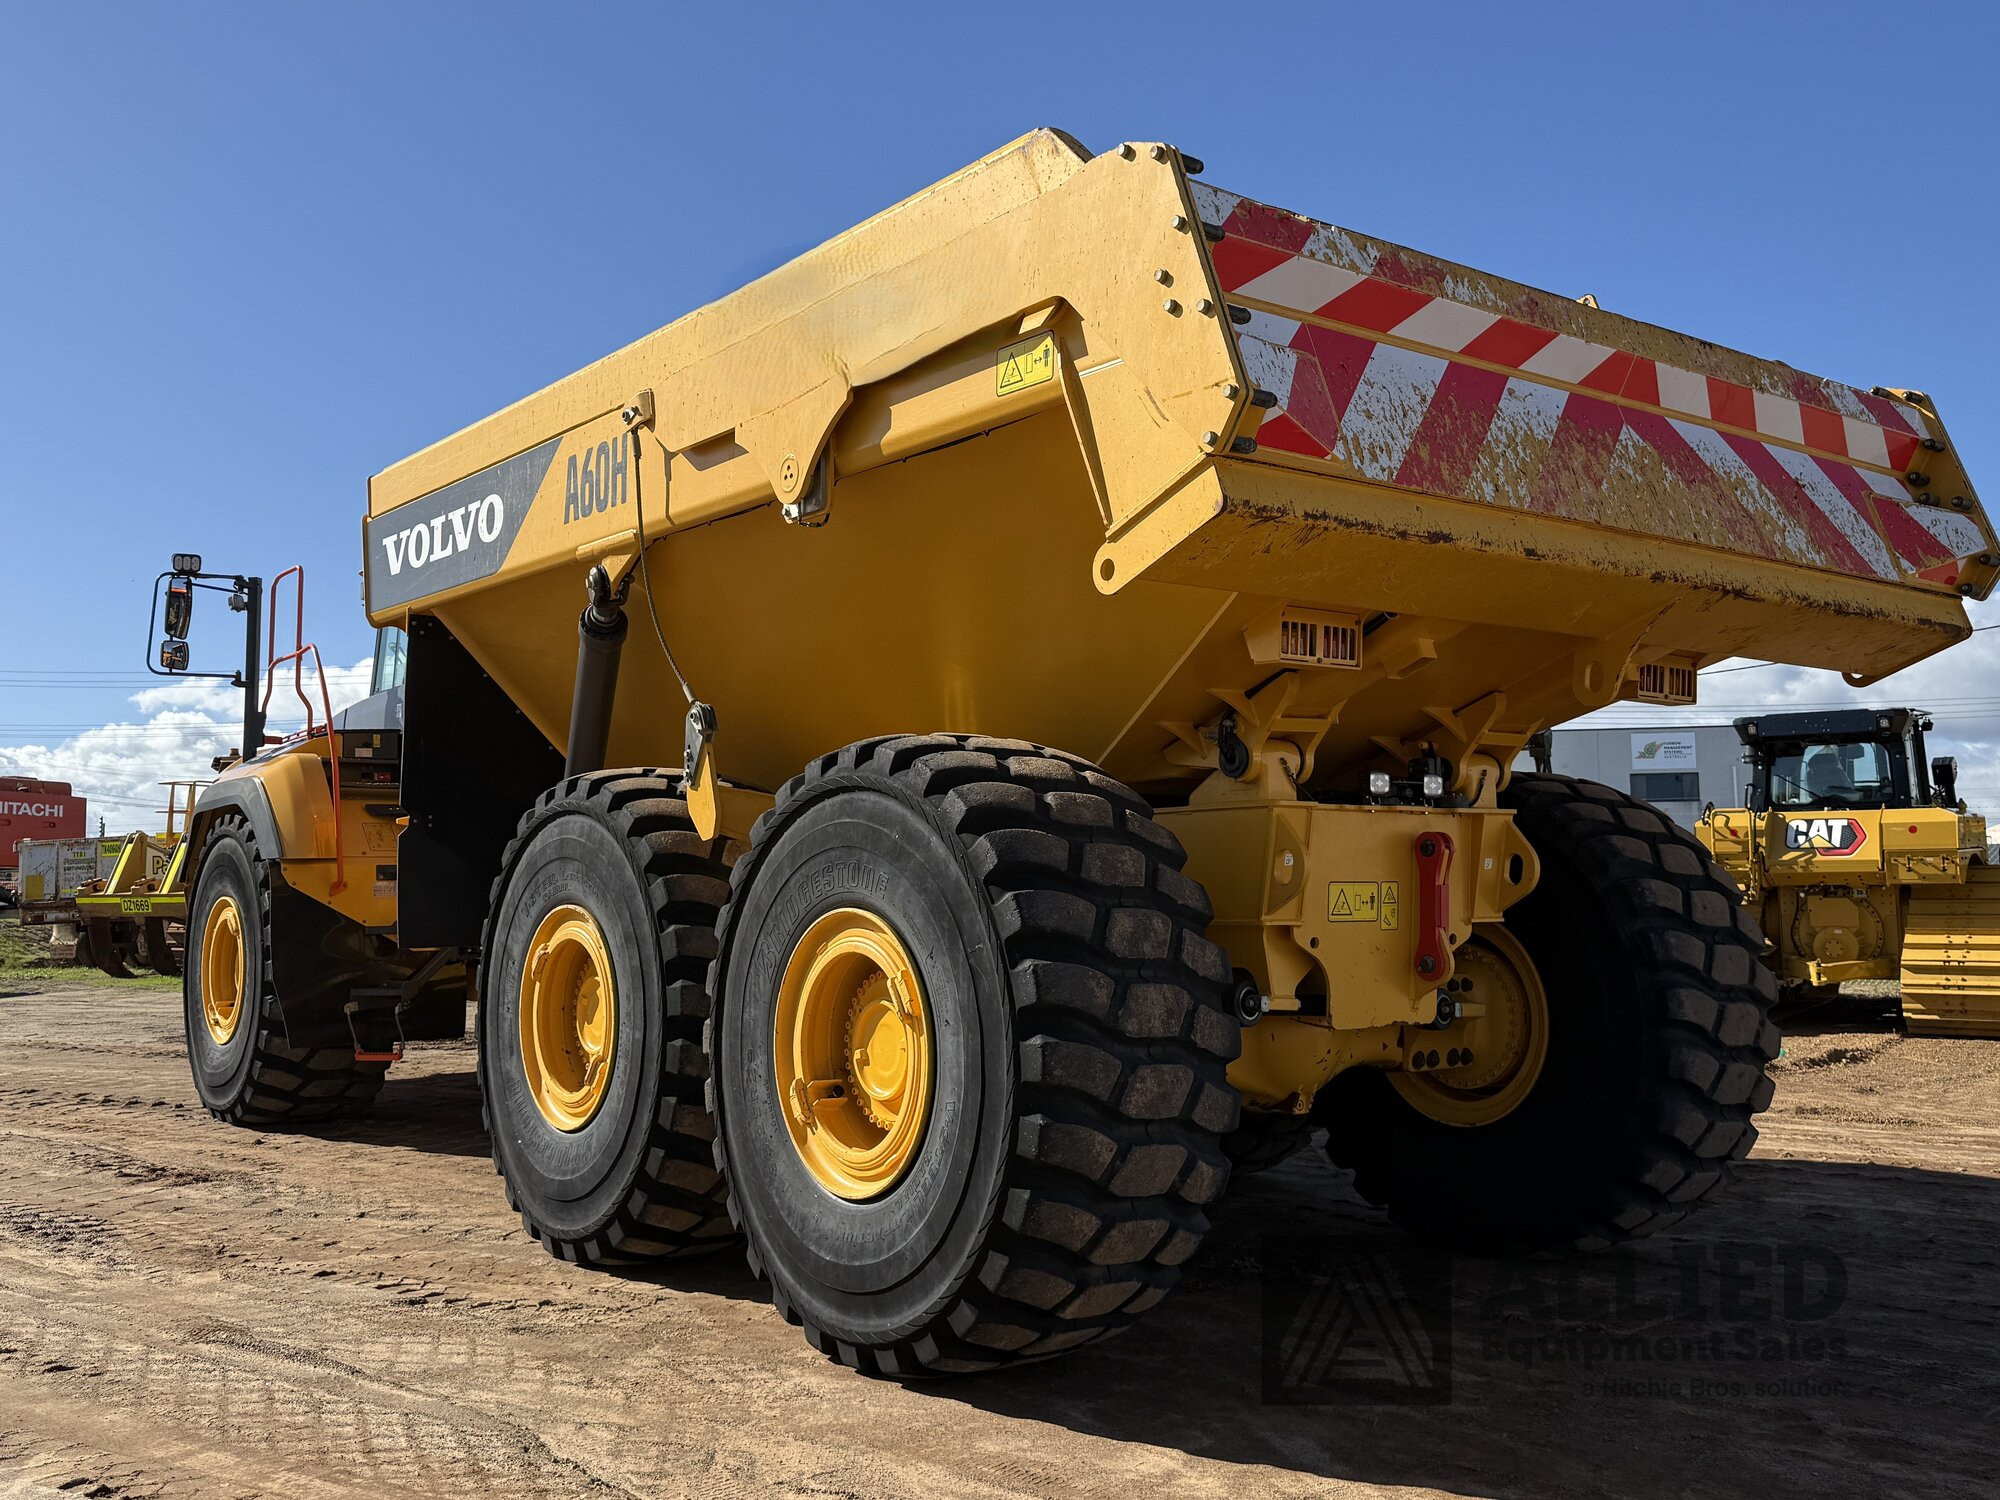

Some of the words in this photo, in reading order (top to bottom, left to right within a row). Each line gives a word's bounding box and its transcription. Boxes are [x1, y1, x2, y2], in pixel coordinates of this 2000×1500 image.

[564, 432, 628, 525] A60H
[382, 494, 504, 577] VOLVO
[0, 801, 64, 818] ITACHI
[1786, 818, 1848, 849] CAT
[123, 899, 151, 912] DZ1669
[756, 859, 891, 984] BRIDGESTONE
